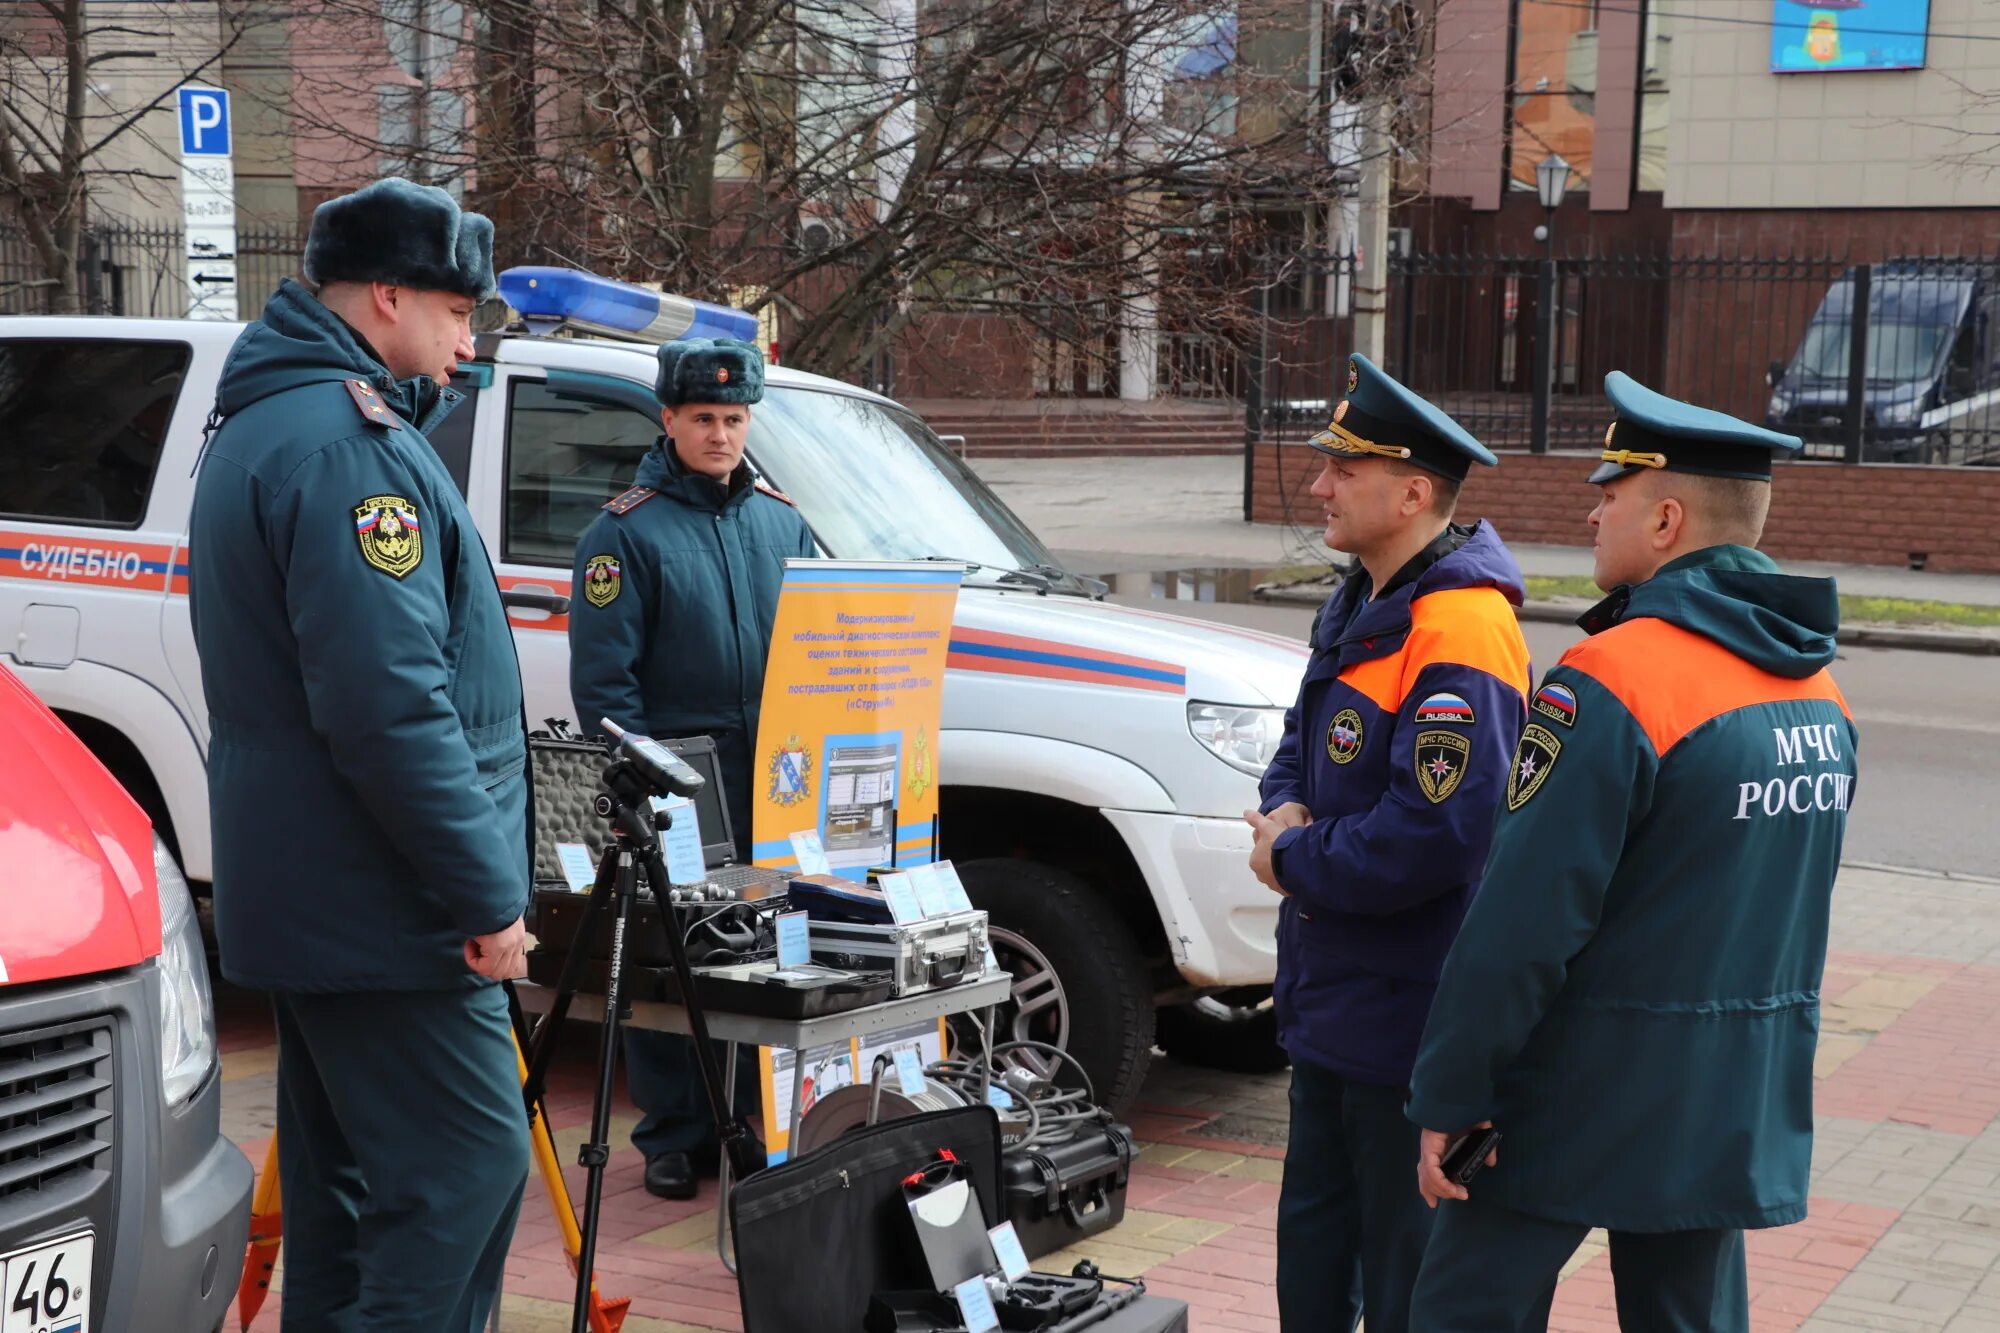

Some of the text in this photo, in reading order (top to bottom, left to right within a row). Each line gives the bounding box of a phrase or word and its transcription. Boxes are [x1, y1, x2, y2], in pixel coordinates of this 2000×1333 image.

[190, 95, 222, 149] P
[793, 630, 845, 641] мобильный
[808, 650, 840, 659] оценки
[828, 668, 862, 676] зданий
[788, 683, 854, 696] пострадавших
[858, 684, 868, 692] от
[1426, 712, 1463, 720] RUSSIA
[1538, 700, 1565, 720] RUSSIA
[1420, 735, 1466, 750] МЧС РОССИИ
[1525, 728, 1556, 752] МЧС РОССИИ
[1773, 723, 1841, 766] МЧС
[611, 917, 625, 979] Manfrotto
[13, 1252, 69, 1325] 46
